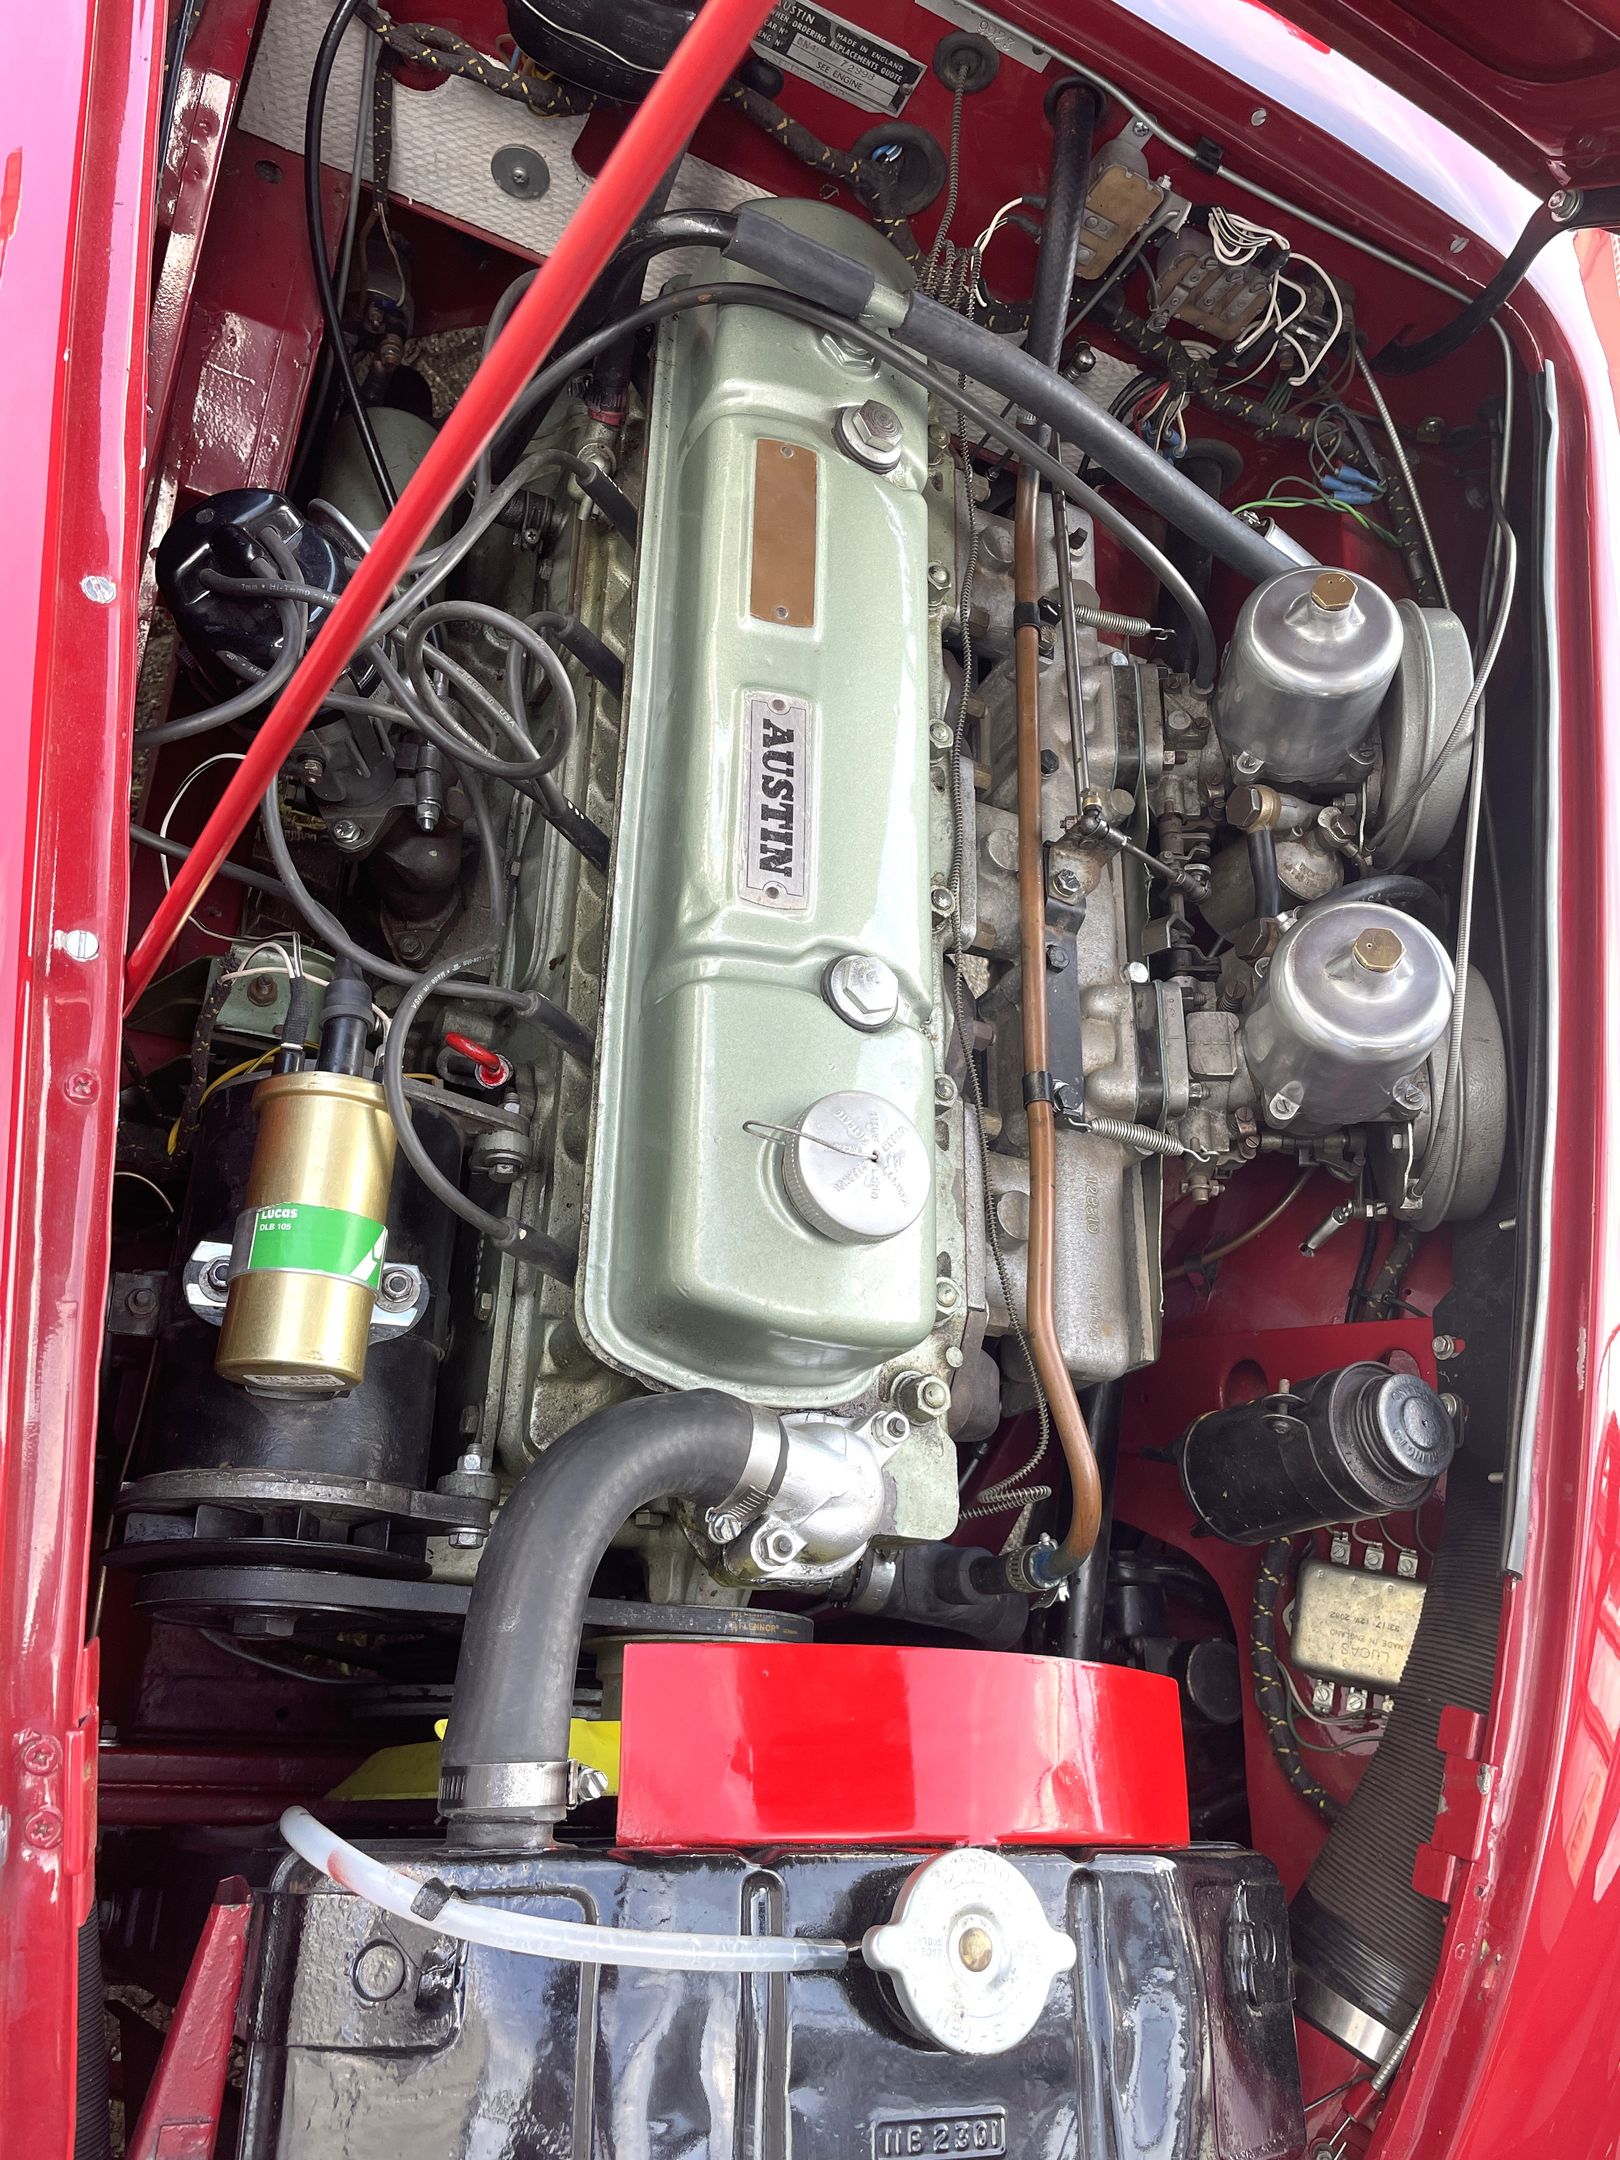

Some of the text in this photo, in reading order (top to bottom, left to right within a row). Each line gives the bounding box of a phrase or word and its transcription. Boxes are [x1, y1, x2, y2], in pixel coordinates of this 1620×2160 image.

[763, 18, 779, 31] CAR
[757, 30, 771, 41] ENG
[815, 61, 830, 73] SEE
[832, 69, 863, 90] ENGINE
[791, 20, 827, 43] ORDERING
[828, 39, 879, 71] REPLACEMENTS
[879, 66, 902, 83] QUOTE
[835, 32, 904, 72] MADE IN ENGLAND
[500, 708, 515, 728] USA
[759, 718, 794, 878] AUSTIN
[410, 993, 423, 1009] USA
[259, 1222, 292, 1231] DLB 105
[1329, 1628, 1365, 1642] ENGLAND
[1381, 1639, 1404, 1650] MADE
[1339, 1642, 1390, 1662] LUCAS
